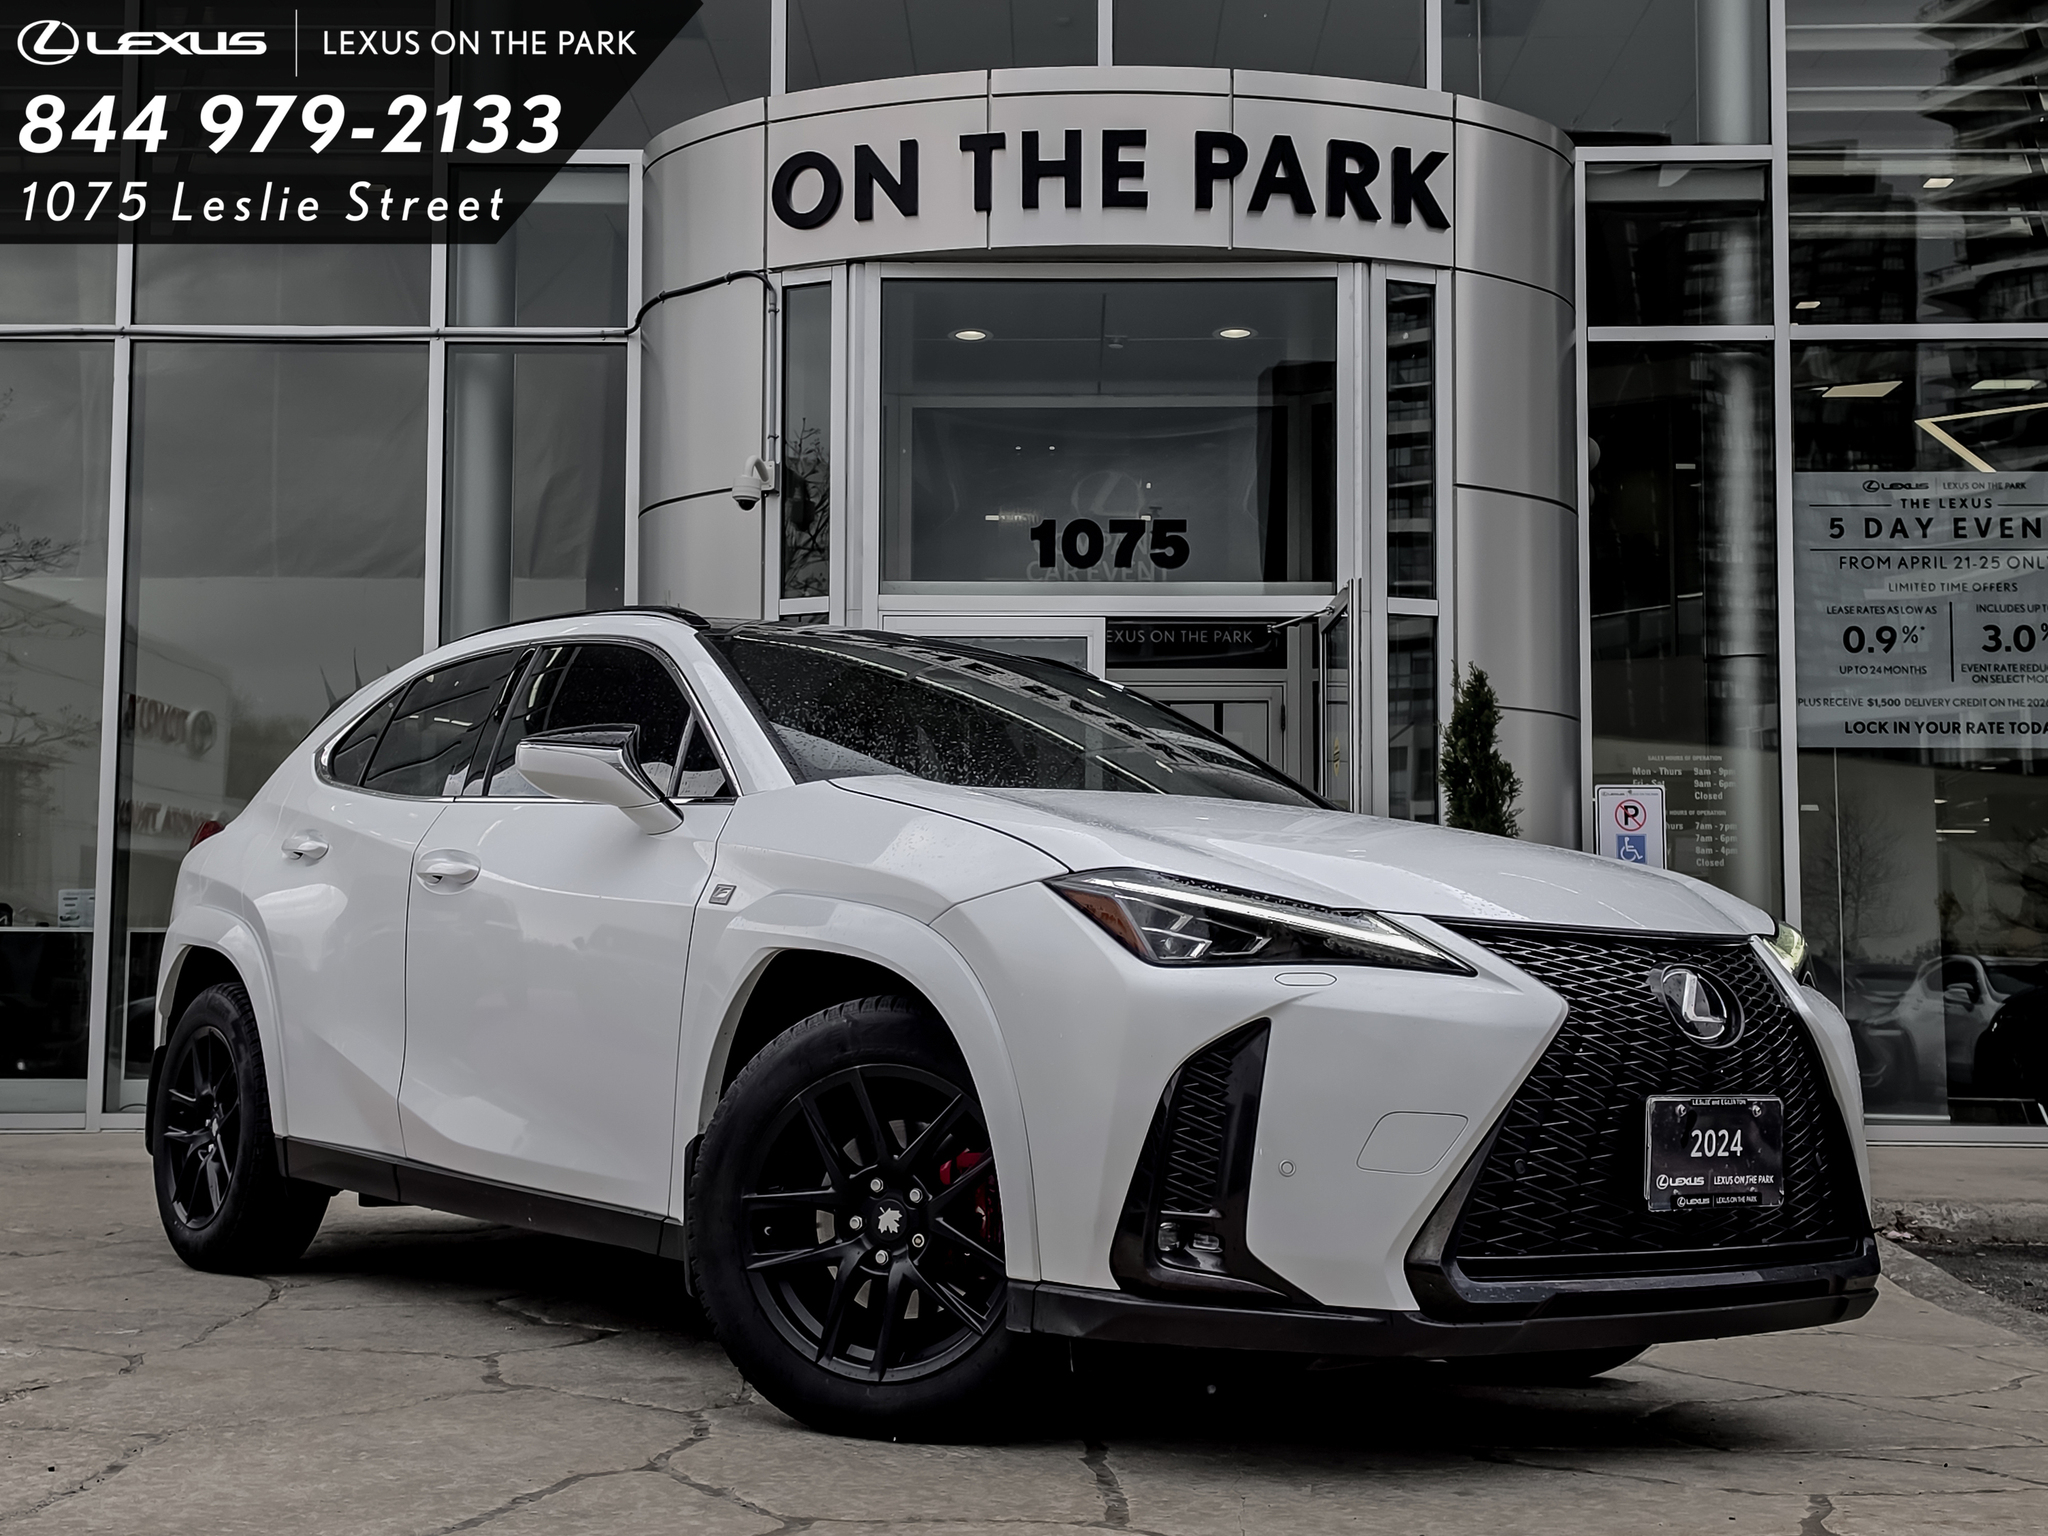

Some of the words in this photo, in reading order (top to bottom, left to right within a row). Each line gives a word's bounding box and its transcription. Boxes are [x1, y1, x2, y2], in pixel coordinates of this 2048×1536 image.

[772, 139, 918, 230] ON
[959, 129, 1149, 213] THE
[1194, 130, 1452, 230] PARK
[1942, 481, 1970, 490] LEXUS
[1971, 481, 1986, 490] ON
[1987, 481, 2003, 490] THE
[2004, 481, 2027, 490] PARK
[1900, 498, 1930, 509] THE
[1938, 498, 1993, 509] LEXUS
[1828, 517, 1845, 539] 5
[1864, 517, 1934, 539] DAY
[1029, 518, 1190, 570] 1075
[1839, 556, 1891, 570] FROM
[1897, 556, 1948, 570] APRIL
[1953, 556, 2001, 570] 21-25
[2006, 556, 2048, 570] ONL
[1888, 582, 1937, 593] LIMITED
[1940, 582, 1969, 593] TIME
[1972, 582, 2018, 593] OFFERS
[1826, 606, 1855, 615] LEASE
[1856, 606, 1886, 615] RATES
[1886, 606, 1899, 615] AS
[1900, 605, 1923, 615] LOW
[1924, 605, 1938, 615] AS
[1975, 603, 2026, 613] INCLUDES
[2026, 603, 2040, 613] UP
[1150, 629, 1175, 643] ON
[1180, 629, 1208, 643] THE
[1213, 629, 1253, 643] PARK
[1839, 665, 1853, 675] UP
[1854, 665, 1868, 675] TO
[1869, 665, 1882, 675] 24
[1883, 665, 1928, 675] MONTHS
[1960, 663, 1992, 673] EVENT
[1993, 663, 2018, 673] RATE
[2019, 663, 2048, 673] REDU
[1971, 674, 1989, 684] ON
[1990, 674, 2025, 684] SELECT
[1797, 698, 1822, 707] PLUS
[1823, 698, 1863, 707] RECEIVE
[1867, 698, 1901, 708] $1,500
[1904, 698, 1950, 707] DELIVERY
[1952, 698, 1987, 707] CREDIT
[1988, 698, 2004, 707] ON
[2006, 698, 2026, 707] THE
[1845, 721, 1889, 735] LOCK
[1893, 721, 1910, 735] IN
[1914, 721, 1961, 735] YOUR
[1966, 721, 2005, 735] RATE
[1632, 767, 1652, 776] Mon
[1659, 767, 1683, 776] Thurs
[1693, 767, 1712, 776] 9am
[1718, 767, 1736, 778] 9pm
[1693, 779, 1712, 788] 9am
[1718, 779, 1736, 790] 6pm
[1694, 791, 1723, 800] Closed
[1695, 821, 1713, 830] 7am
[1719, 823, 1738, 832] 7pm
[1695, 833, 1713, 842] 7am
[1719, 833, 1738, 844] 6pm
[1695, 846, 1713, 855] 8am
[1720, 846, 1738, 856] 4pm
[1696, 858, 1725, 867] Closed
[1690, 1129, 1744, 1157] 2024
[1669, 1176, 1705, 1186] LEXUS
[1713, 1175, 1733, 1185] LEXUS
[1734, 1175, 1745, 1185] ON
[1746, 1175, 1757, 1185] THE
[1758, 1175, 1774, 1184] PARK
